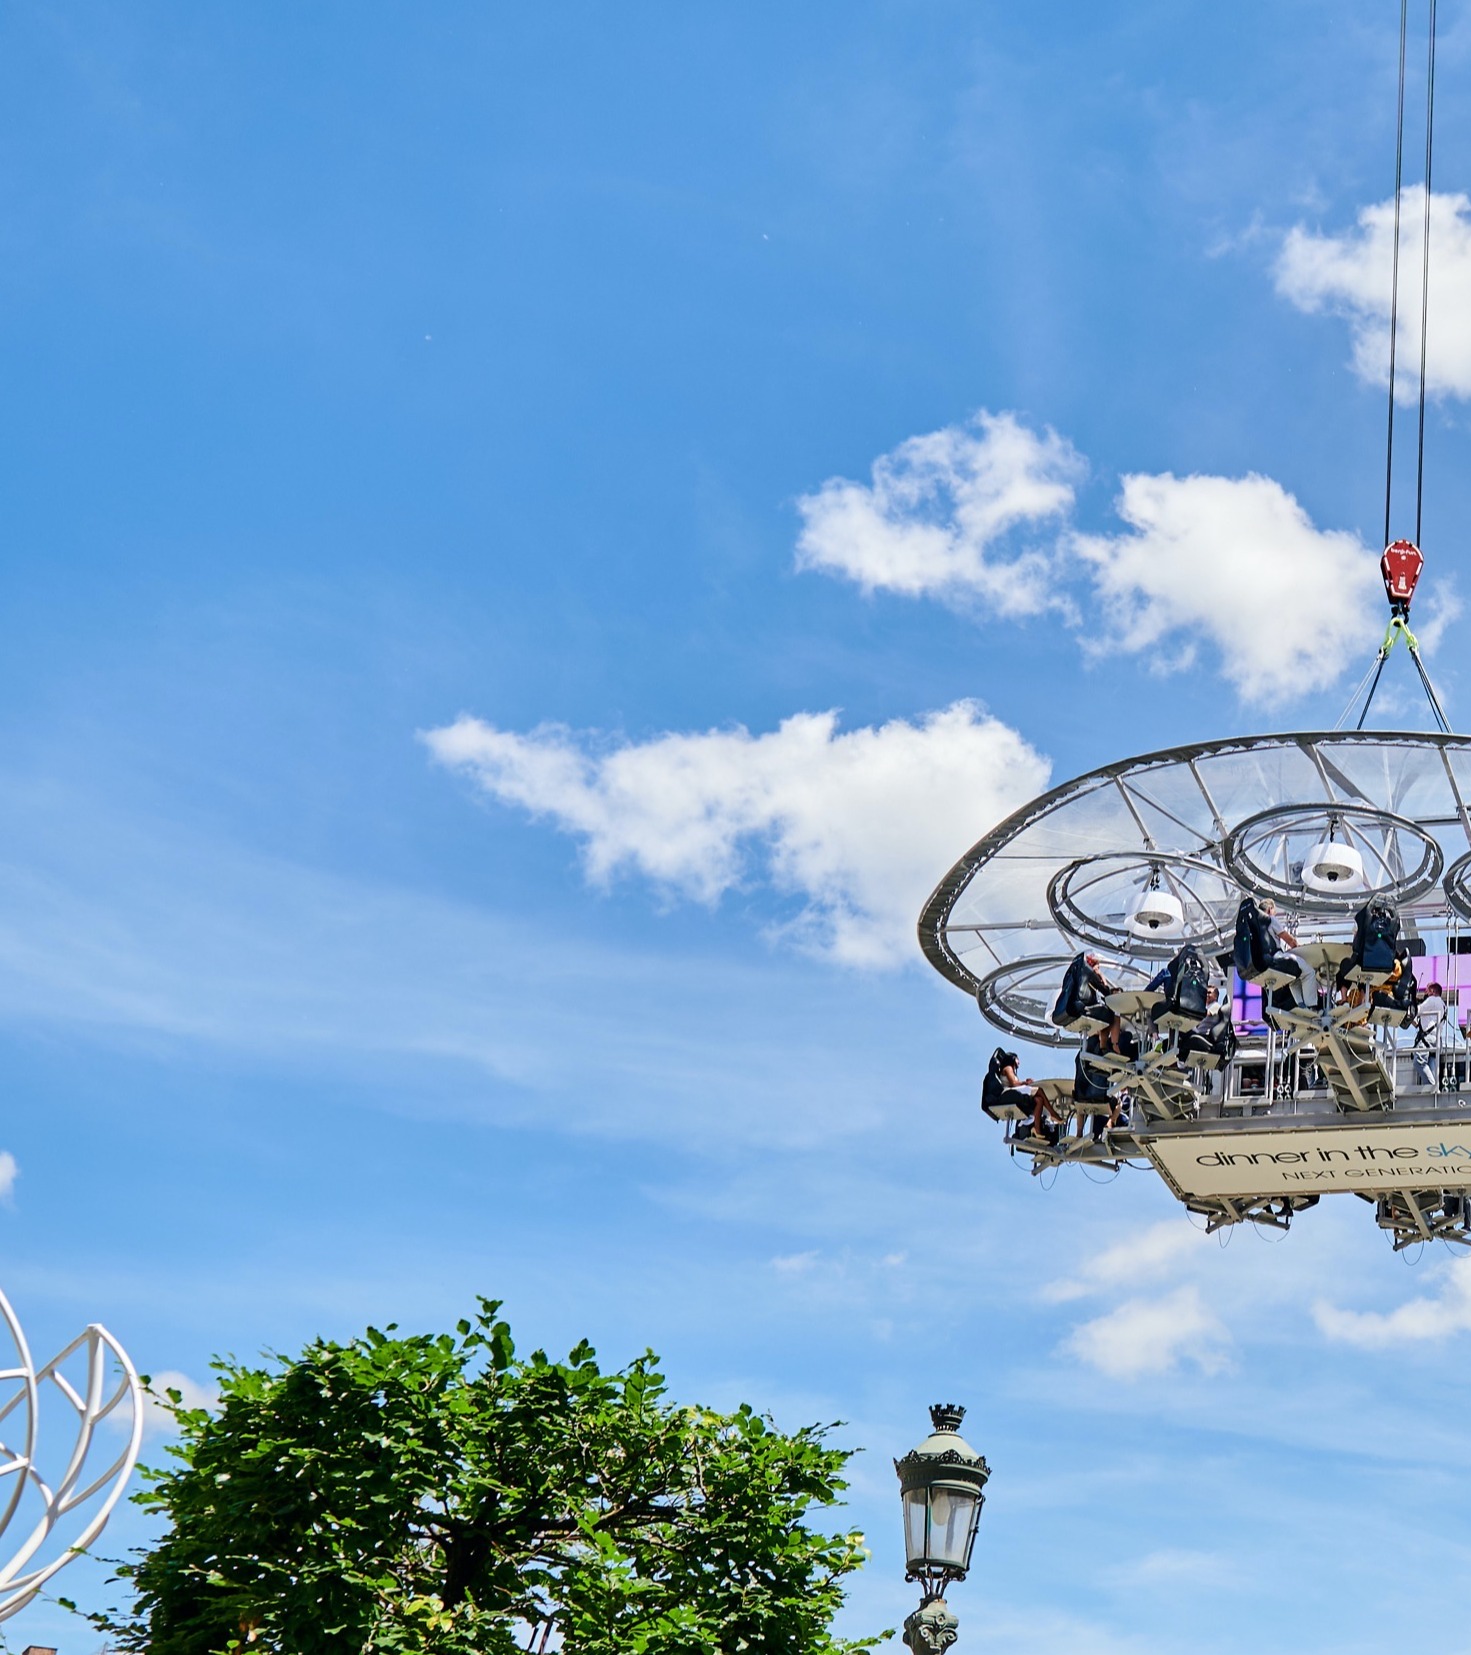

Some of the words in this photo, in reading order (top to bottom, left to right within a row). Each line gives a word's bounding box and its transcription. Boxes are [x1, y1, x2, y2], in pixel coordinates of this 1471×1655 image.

[1196, 1150, 1310, 1167] dinner
[1316, 1147, 1350, 1163] in
[1353, 1145, 1419, 1161] the
[1281, 1170, 1336, 1181] NEXT
